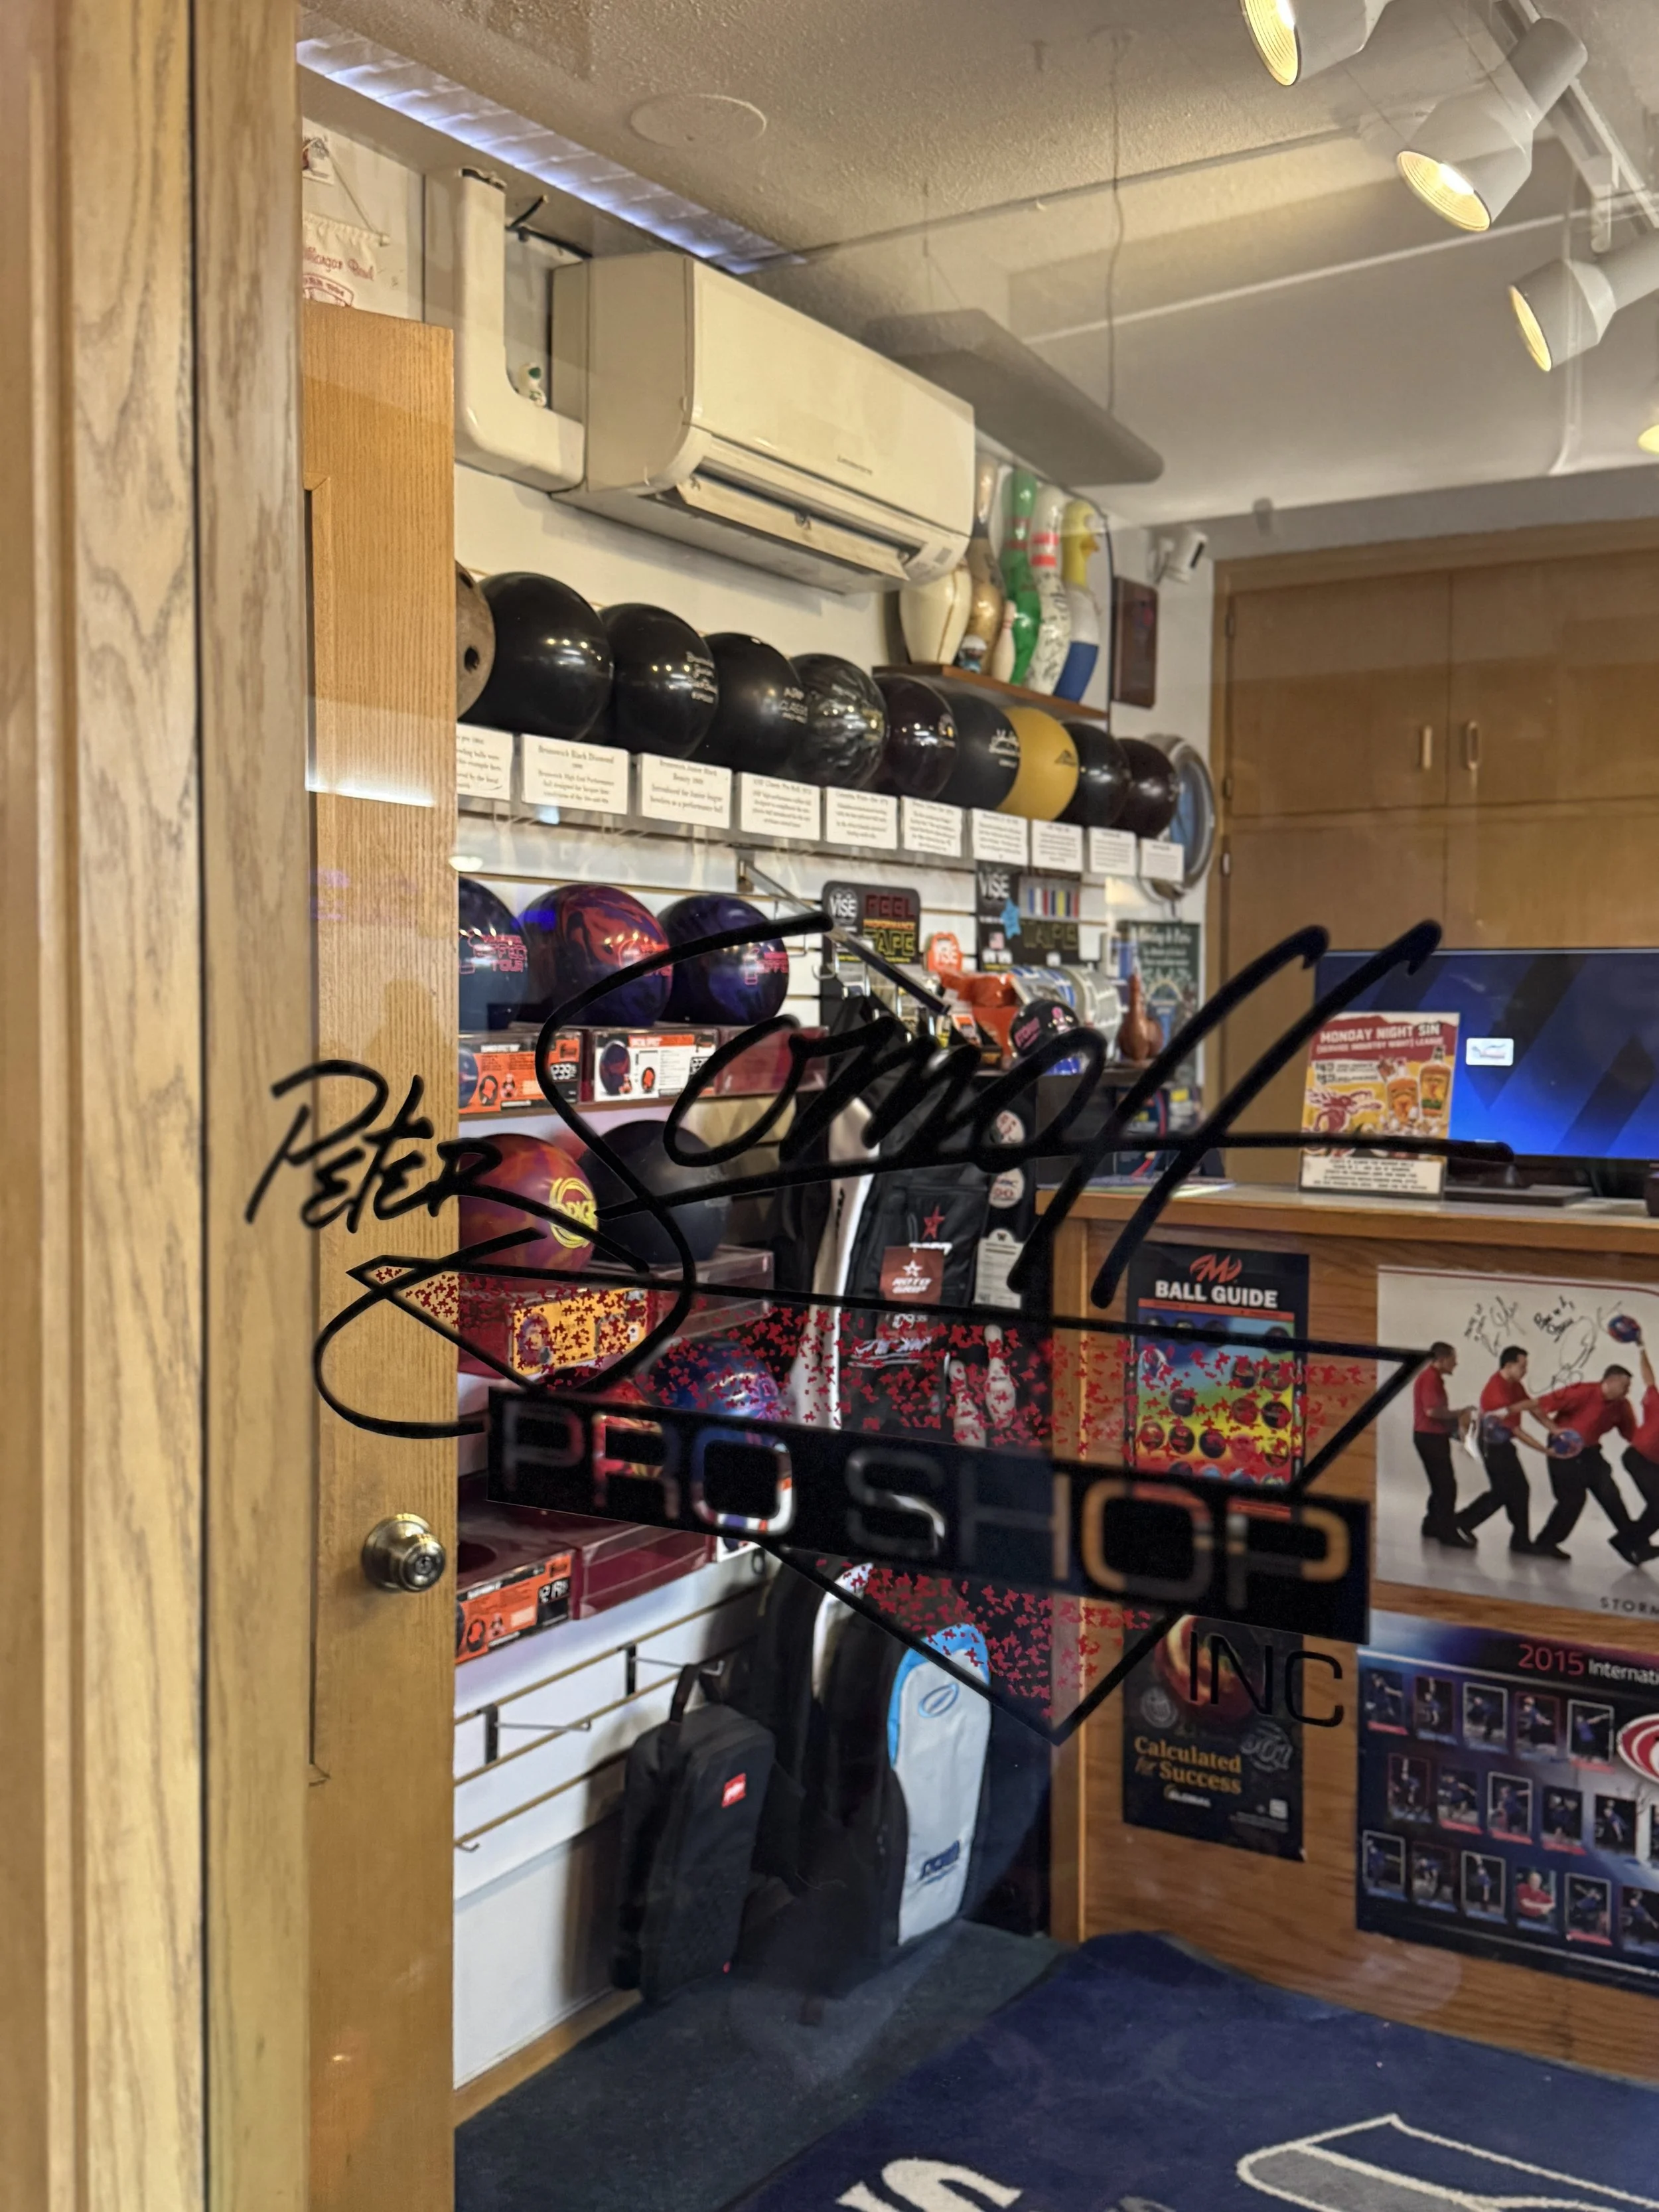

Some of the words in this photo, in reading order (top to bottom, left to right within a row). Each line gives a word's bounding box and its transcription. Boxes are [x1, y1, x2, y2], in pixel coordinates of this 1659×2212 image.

[830, 892, 857, 919] VISE
[865, 894, 916, 919] FEEL
[863, 928, 916, 958] TAPE
[1320, 1027, 1373, 1044] MONDAY
[1376, 1025, 1415, 1039] NIGHT
[1154, 1280, 1207, 1303] BALL
[1210, 1285, 1279, 1308] GUIDE
[503, 1397, 794, 1536] PRO
[843, 1443, 1351, 1614] SHOP
[1518, 1643, 1585, 1676] 2015
[1189, 1631, 1345, 1728] INC
[1133, 1735, 1242, 1774] Calculated
[1159, 1759, 1242, 1795] Success
